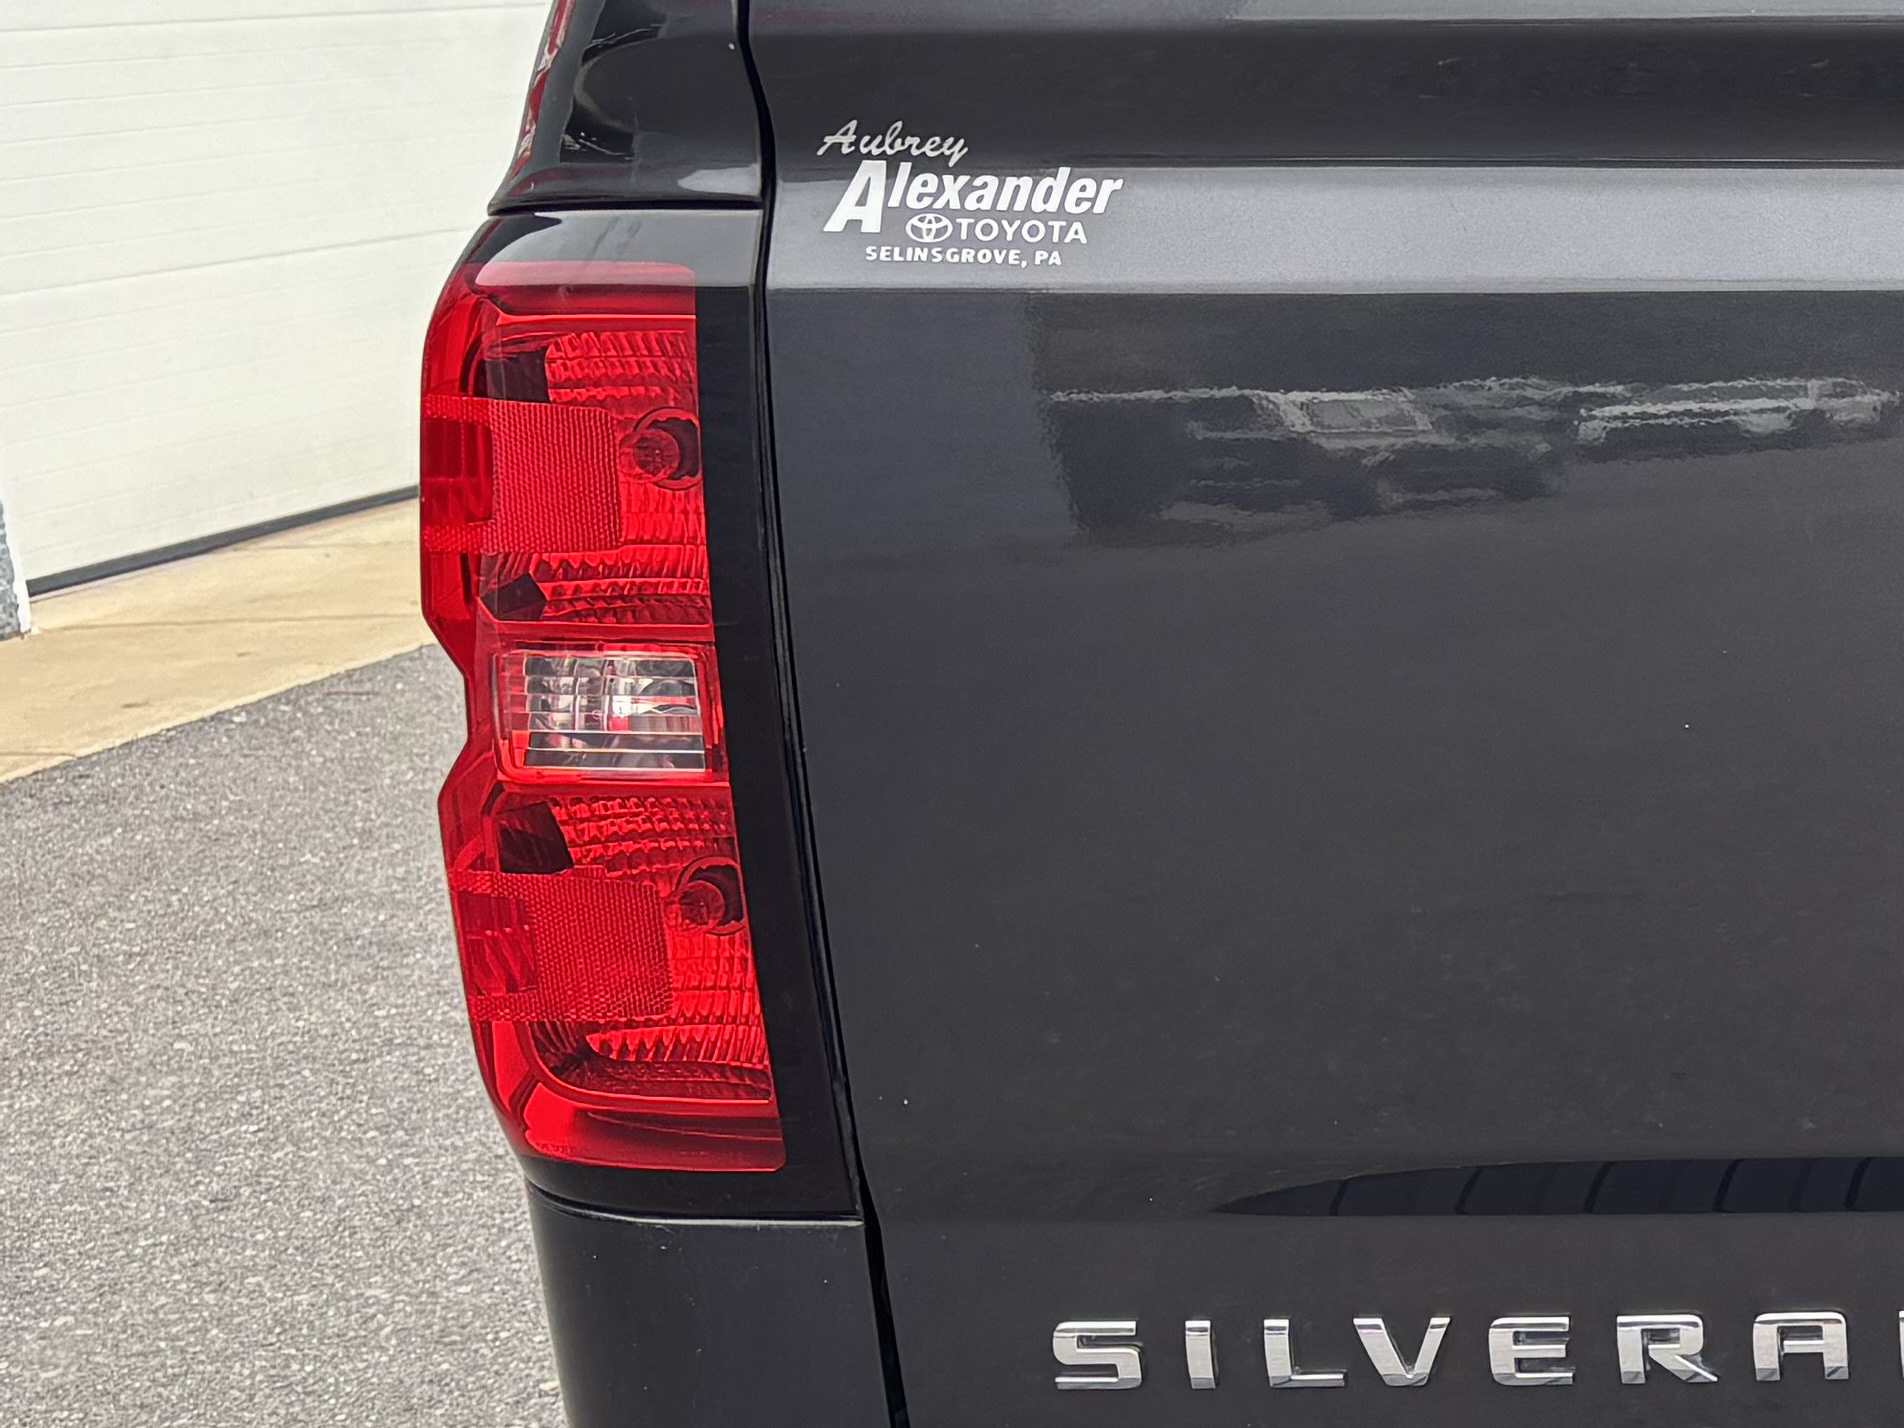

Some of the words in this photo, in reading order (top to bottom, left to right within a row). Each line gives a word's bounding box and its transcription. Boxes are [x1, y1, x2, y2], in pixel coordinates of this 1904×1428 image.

[816, 119, 968, 167] Aubrey
[822, 160, 1124, 233] Alexander
[956, 218, 1088, 245] TOYOTA
[865, 246, 1028, 269] SELINSGROVE,
[1034, 250, 1062, 266] PA
